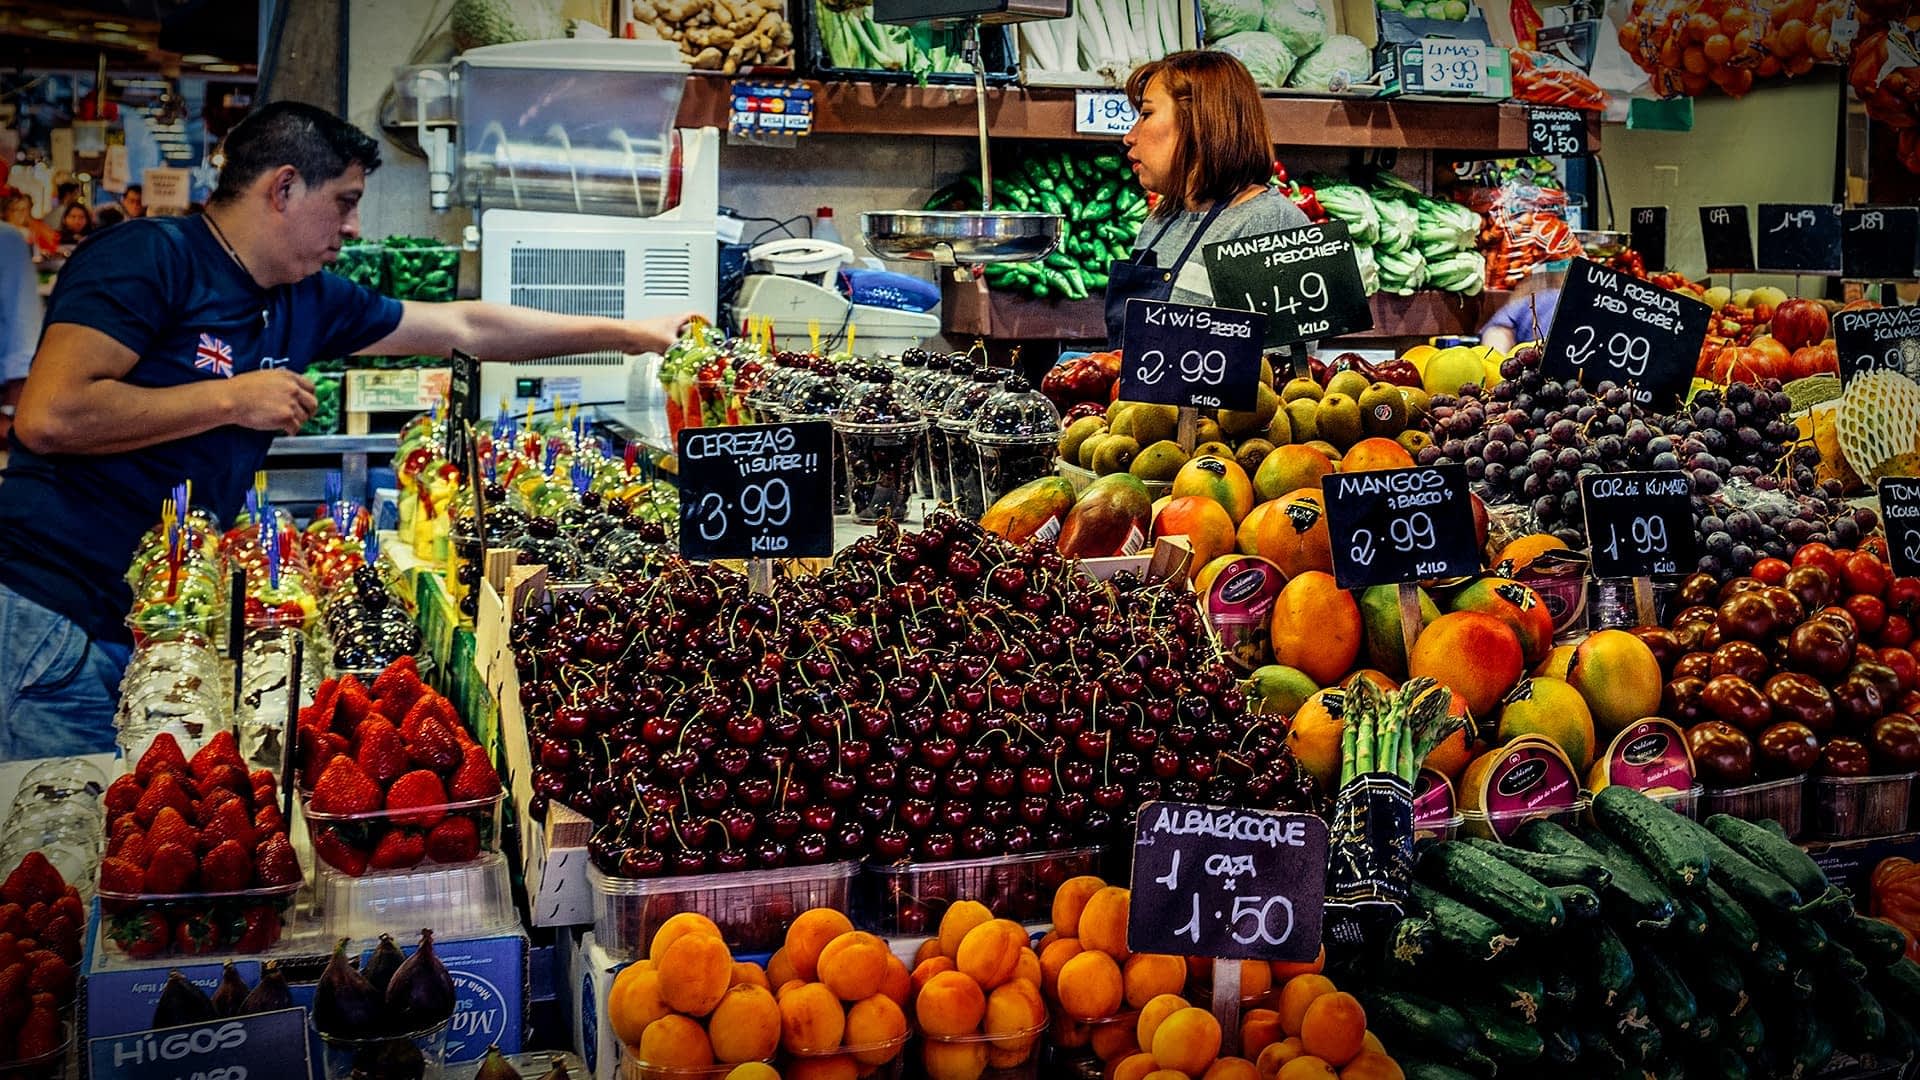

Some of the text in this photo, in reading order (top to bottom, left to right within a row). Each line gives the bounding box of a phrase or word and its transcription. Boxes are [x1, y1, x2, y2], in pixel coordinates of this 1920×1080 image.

[1428, 44, 1480, 58] LIMAS
[1533, 123, 1548, 142] 2
[1217, 227, 1324, 261] MANZANAS
[1587, 266, 1681, 316] UVA ROSADA
[1599, 295, 1674, 331] RED GLOBE
[1843, 308, 1920, 332] PAPAYAS
[1298, 319, 1330, 337] KILO
[1191, 394, 1221, 408] KILO
[686, 427, 796, 459] CEREZAS
[1338, 470, 1445, 500] MANGOS
[1592, 478, 1624, 498] COR
[1415, 561, 1447, 576] KILO
[1155, 849, 1257, 890] 1 CAJA
